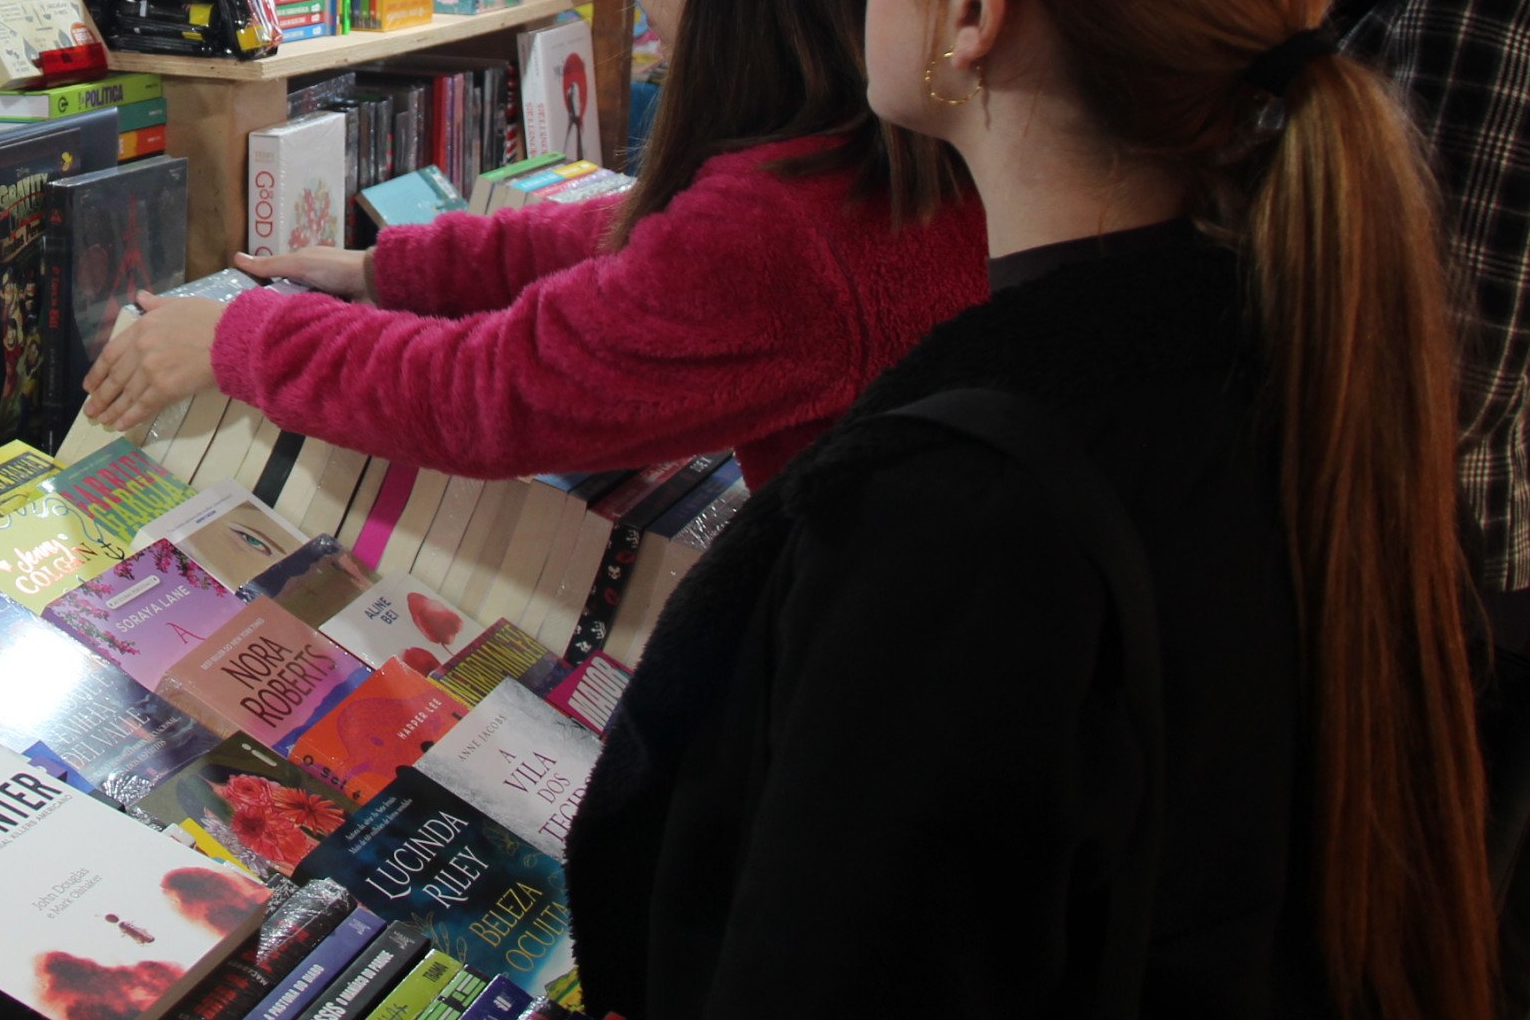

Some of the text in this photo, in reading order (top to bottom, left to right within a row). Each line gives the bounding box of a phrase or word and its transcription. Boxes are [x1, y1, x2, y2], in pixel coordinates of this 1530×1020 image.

[84, 84, 125, 109] POLÍTICA
[14, 533, 69, 574] Jenny
[15, 541, 99, 595] COLGAN
[115, 584, 192, 634] SORAYA LANE
[363, 595, 393, 621] ALINE
[381, 609, 400, 625] BEI
[220, 635, 294, 691] NORA
[239, 643, 338, 729] ROBERTS
[567, 655, 631, 732] MAIOR
[397, 697, 444, 741] HARPER LEE
[497, 747, 518, 765] A
[503, 750, 558, 797] VILA
[536, 772, 572, 805] DOS
[365, 810, 470, 900] LUCINDA
[421, 844, 491, 909] RILEY
[31, 865, 91, 911] John Douglas
[52, 897, 74, 916] Mark
[469, 882, 544, 948] BELEZA
[505, 900, 571, 972] OCULTA
